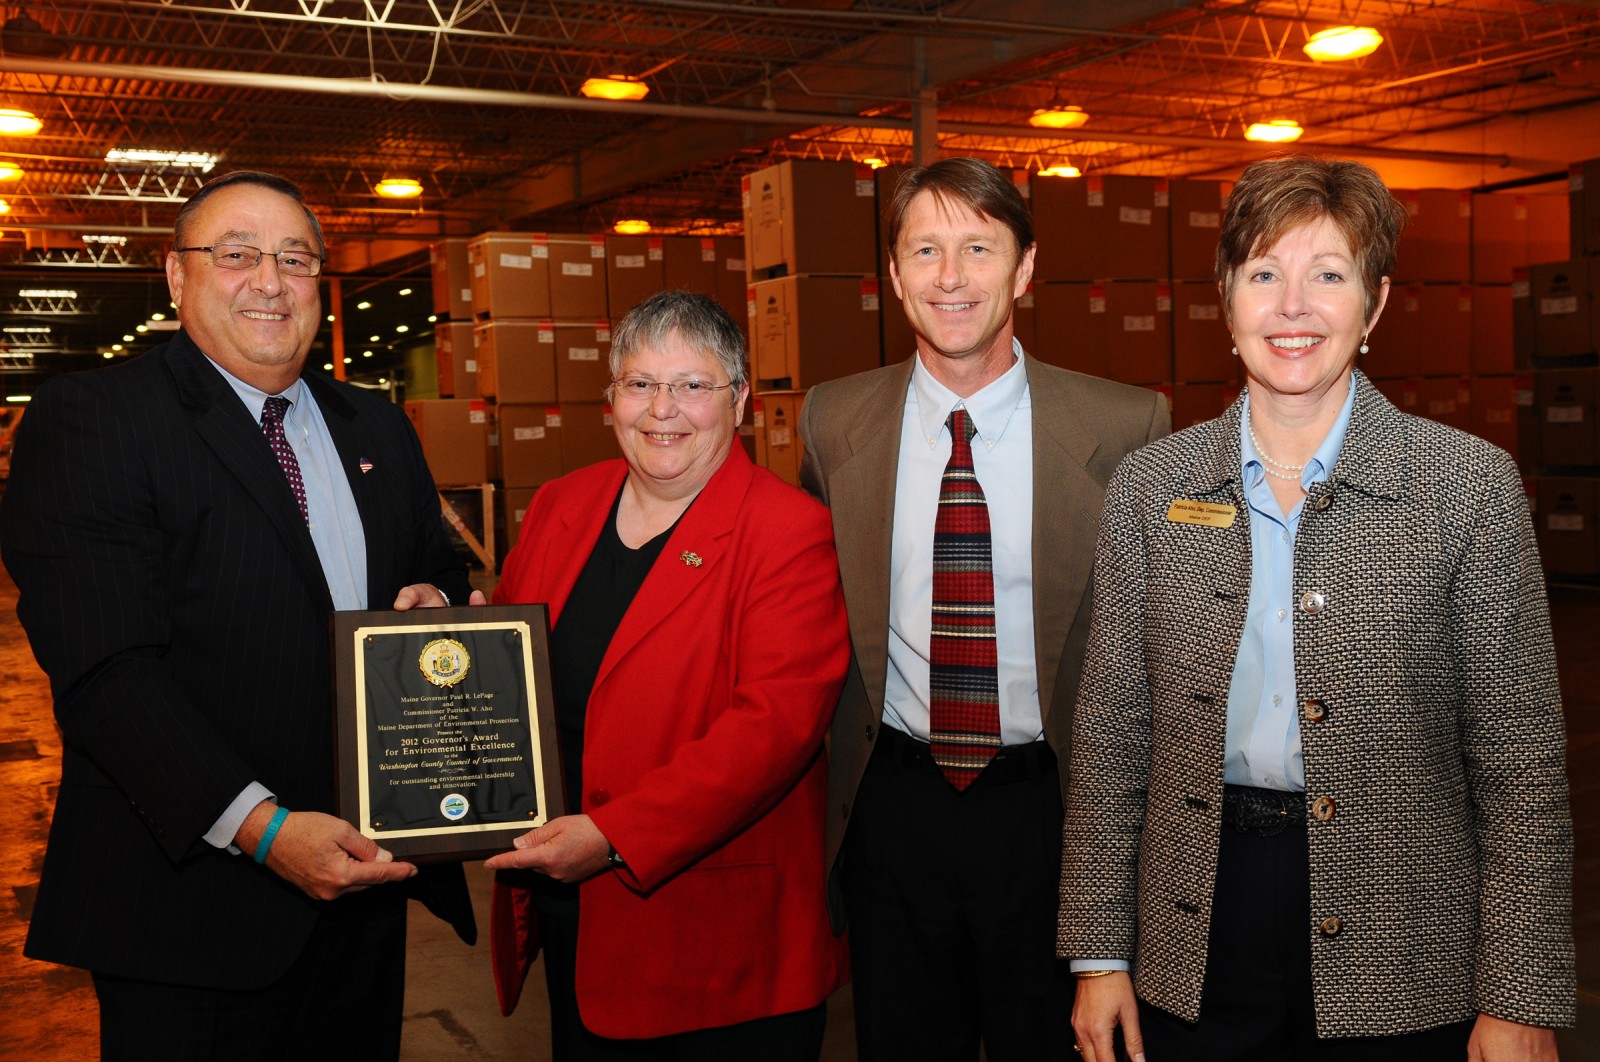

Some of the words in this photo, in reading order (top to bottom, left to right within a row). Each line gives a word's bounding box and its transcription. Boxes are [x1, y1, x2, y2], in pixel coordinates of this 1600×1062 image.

[422, 736, 468, 745] Governor's
[403, 744, 466, 755] Environmental
[471, 742, 515, 750] Excellence
[378, 761, 418, 770] Washington
[482, 755, 522, 764] Governments
